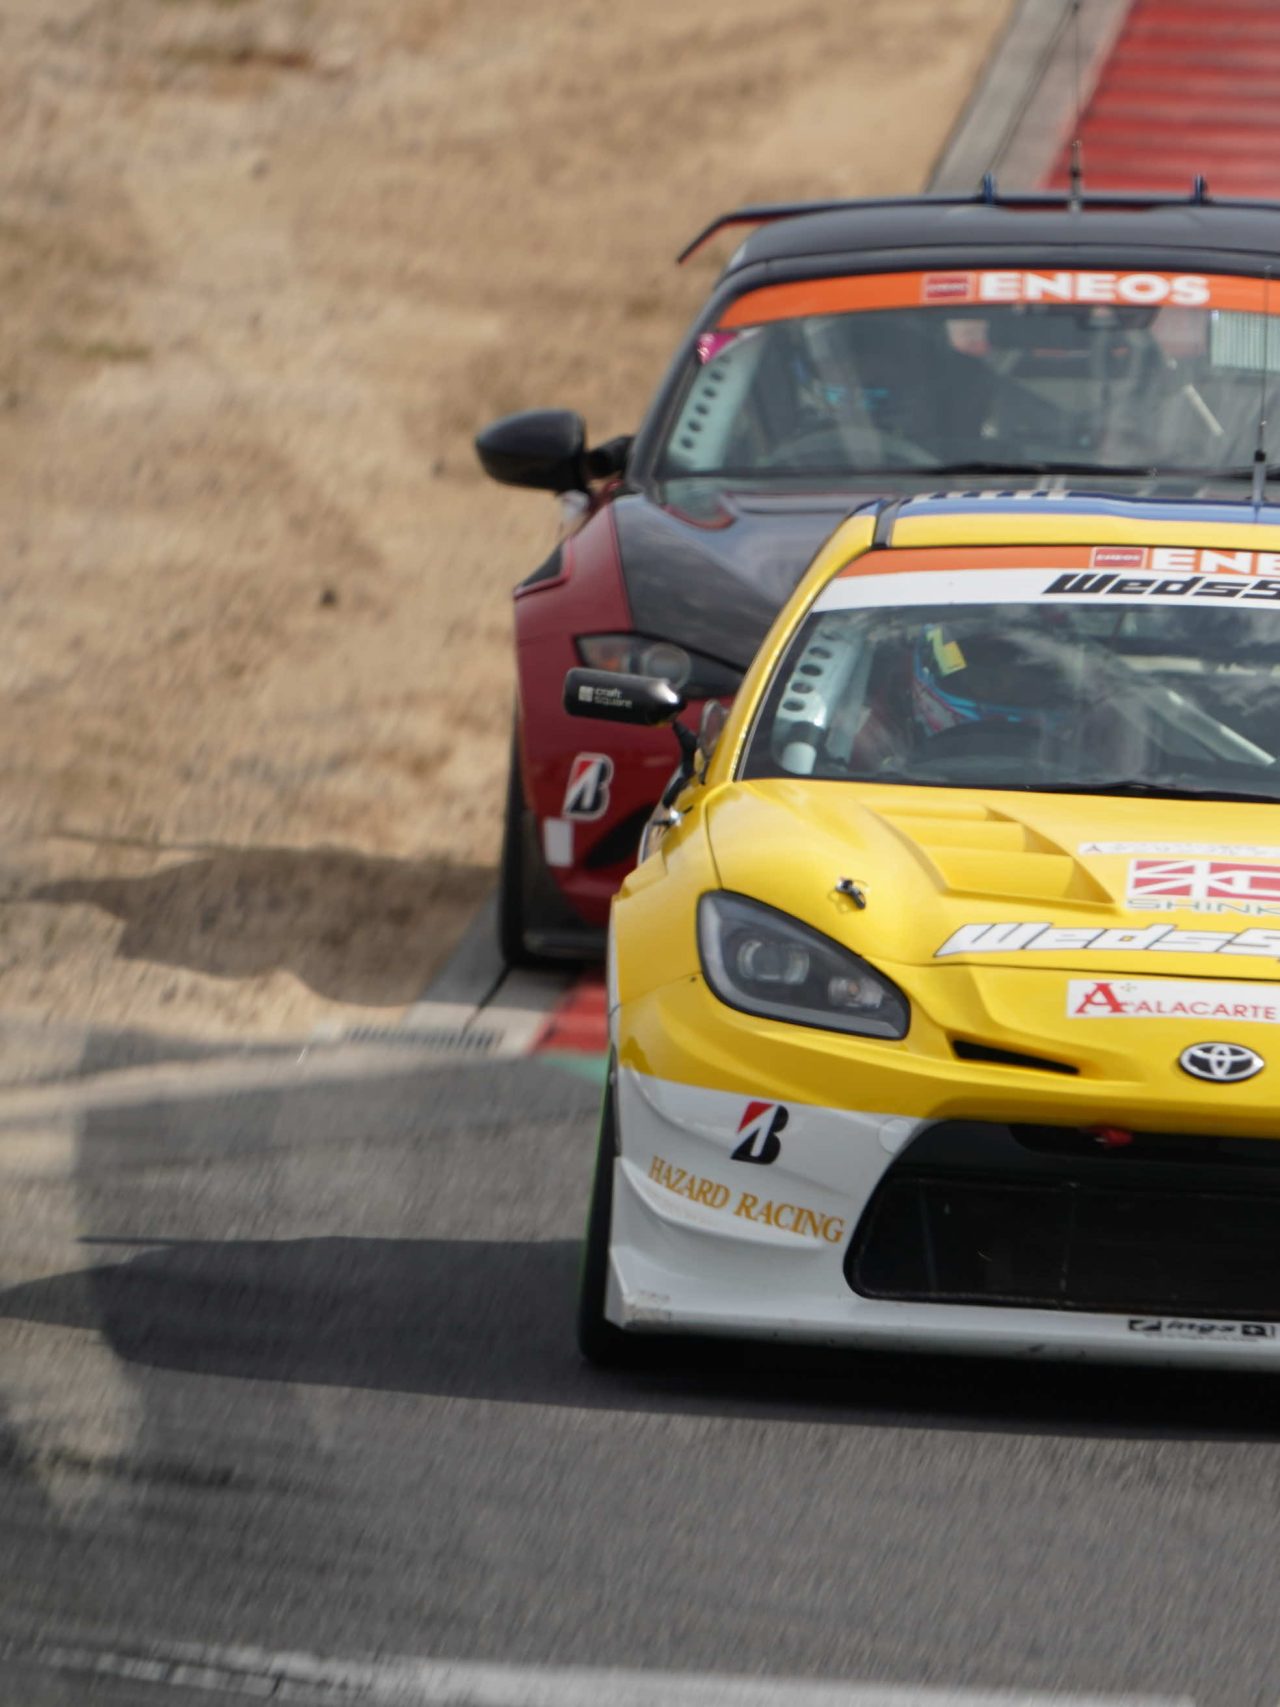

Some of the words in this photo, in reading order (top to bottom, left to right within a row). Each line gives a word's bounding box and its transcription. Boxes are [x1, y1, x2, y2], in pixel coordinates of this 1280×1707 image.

[980, 272, 1211, 306] ENEOS
[648, 1154, 731, 1209] HAZARD
[733, 1191, 846, 1244] RACING
